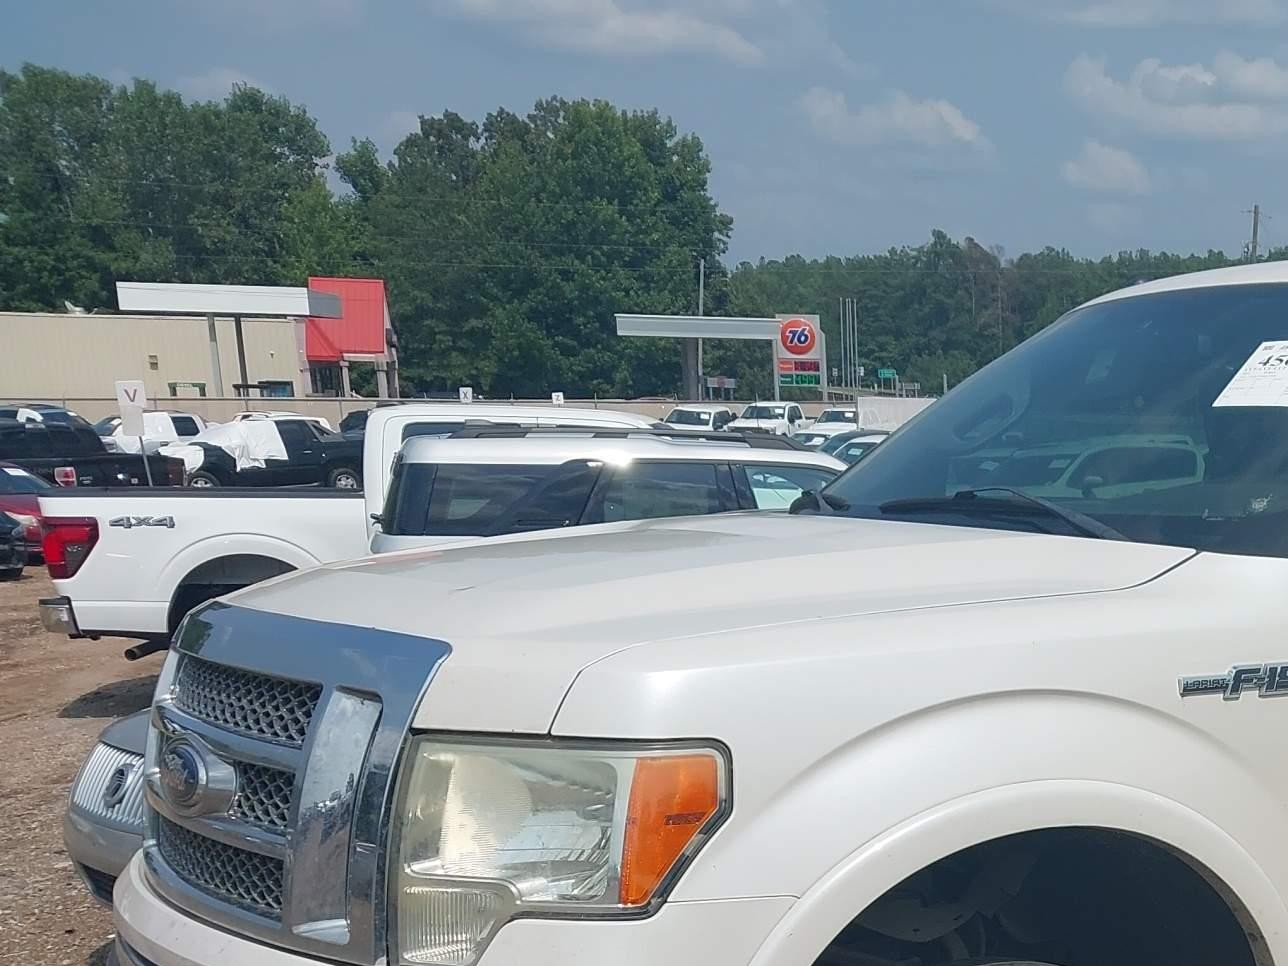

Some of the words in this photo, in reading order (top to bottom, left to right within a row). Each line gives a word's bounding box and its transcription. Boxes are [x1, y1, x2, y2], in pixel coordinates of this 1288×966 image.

[786, 327, 810, 346] 76
[124, 389, 137, 402] V
[1183, 679, 1229, 690] LARIAT
